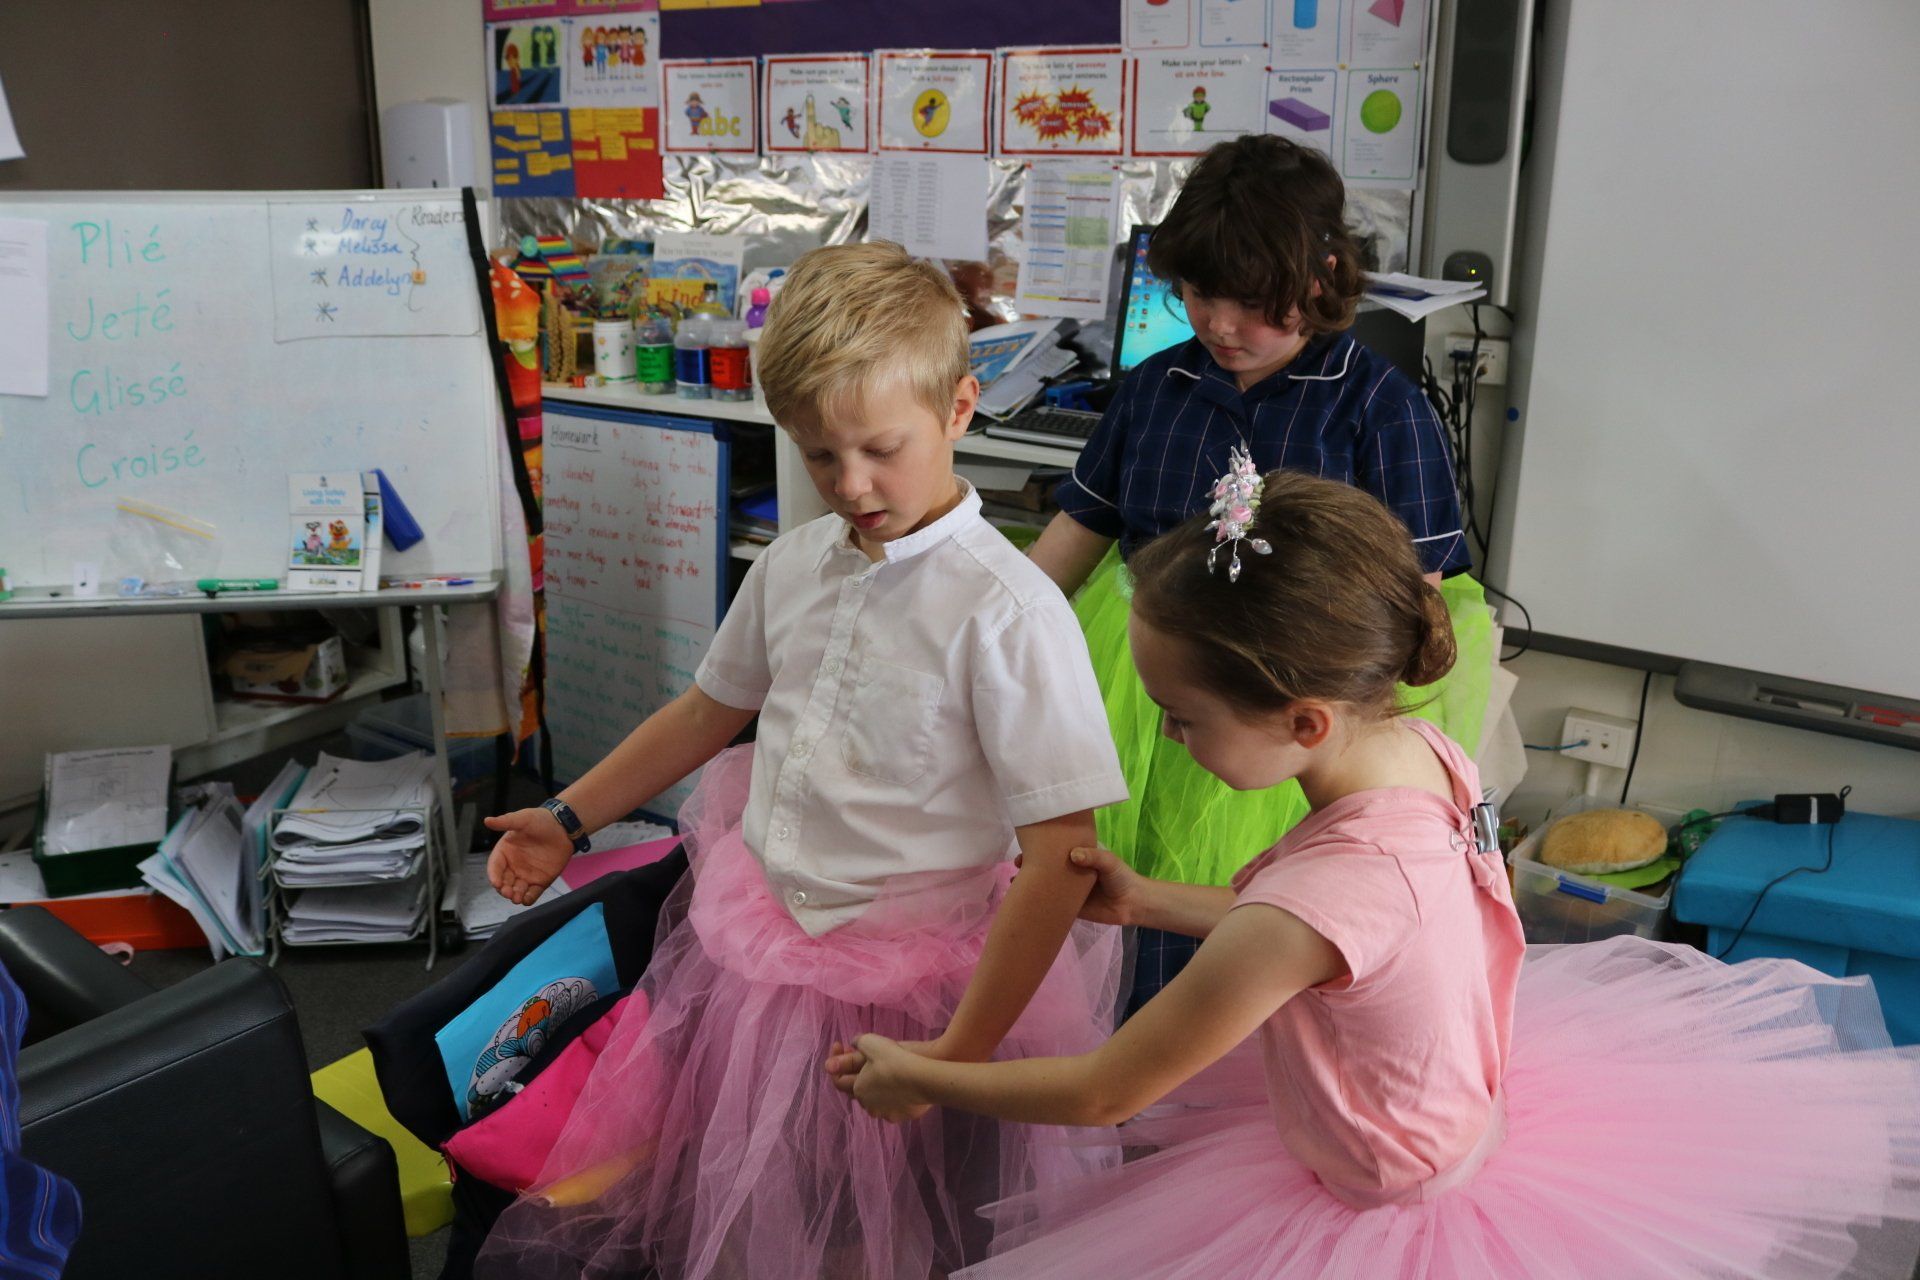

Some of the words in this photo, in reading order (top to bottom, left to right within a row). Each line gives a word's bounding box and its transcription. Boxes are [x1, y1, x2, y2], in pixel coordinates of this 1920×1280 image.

[1066, 61, 1074, 71] of
[1161, 59, 1181, 67] Make
[1199, 60, 1216, 69] your
[1218, 57, 1242, 66] letters
[1057, 74, 1073, 82] your
[1174, 70, 1183, 78] sit
[1197, 70, 1208, 78] the
[1278, 75, 1326, 84] Rectangular
[1366, 73, 1400, 85] Sphere
[1289, 84, 1313, 93] Prism
[699, 104, 742, 137] abc
[70, 218, 168, 269] Plié
[337, 236, 403, 255] Melissa
[66, 288, 175, 343] Jeté
[69, 361, 189, 417] Glissé
[551, 424, 600, 446] Homework
[76, 429, 206, 489] Croisé
[544, 495, 581, 525] omething
